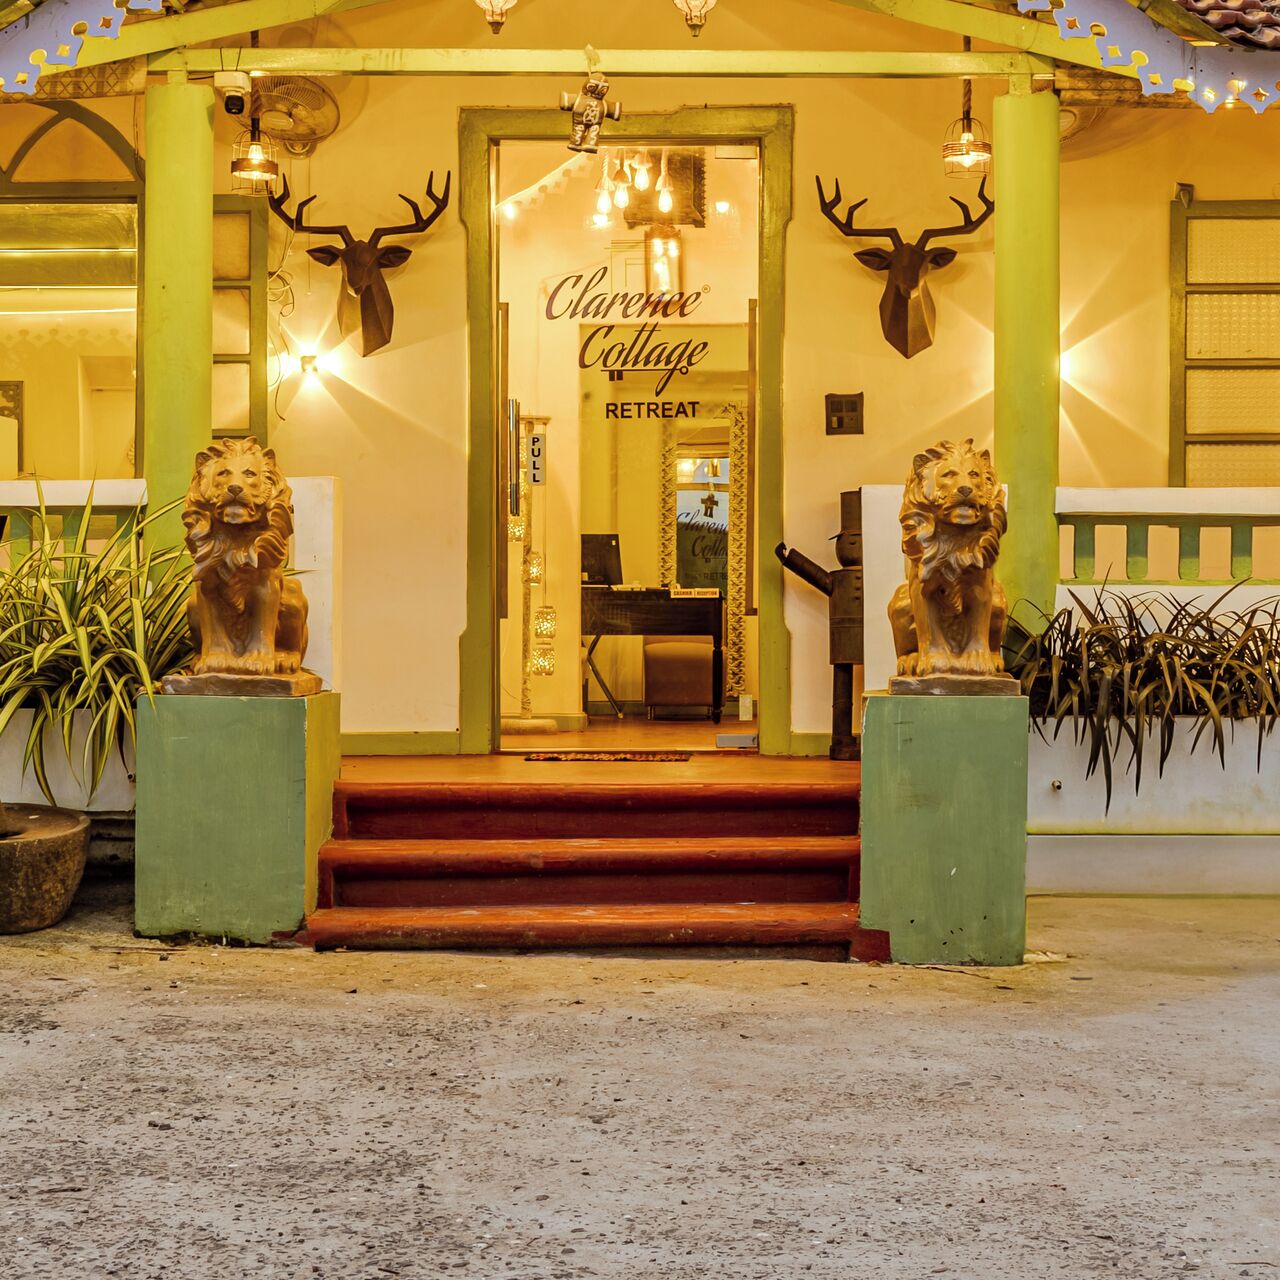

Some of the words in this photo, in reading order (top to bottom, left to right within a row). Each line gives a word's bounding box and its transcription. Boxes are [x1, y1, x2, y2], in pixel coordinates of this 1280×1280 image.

[545, 266, 703, 321] Clarence
[578, 322, 709, 397] Cottage
[605, 401, 700, 419] RETREAT
[531, 436, 541, 483] PULL
